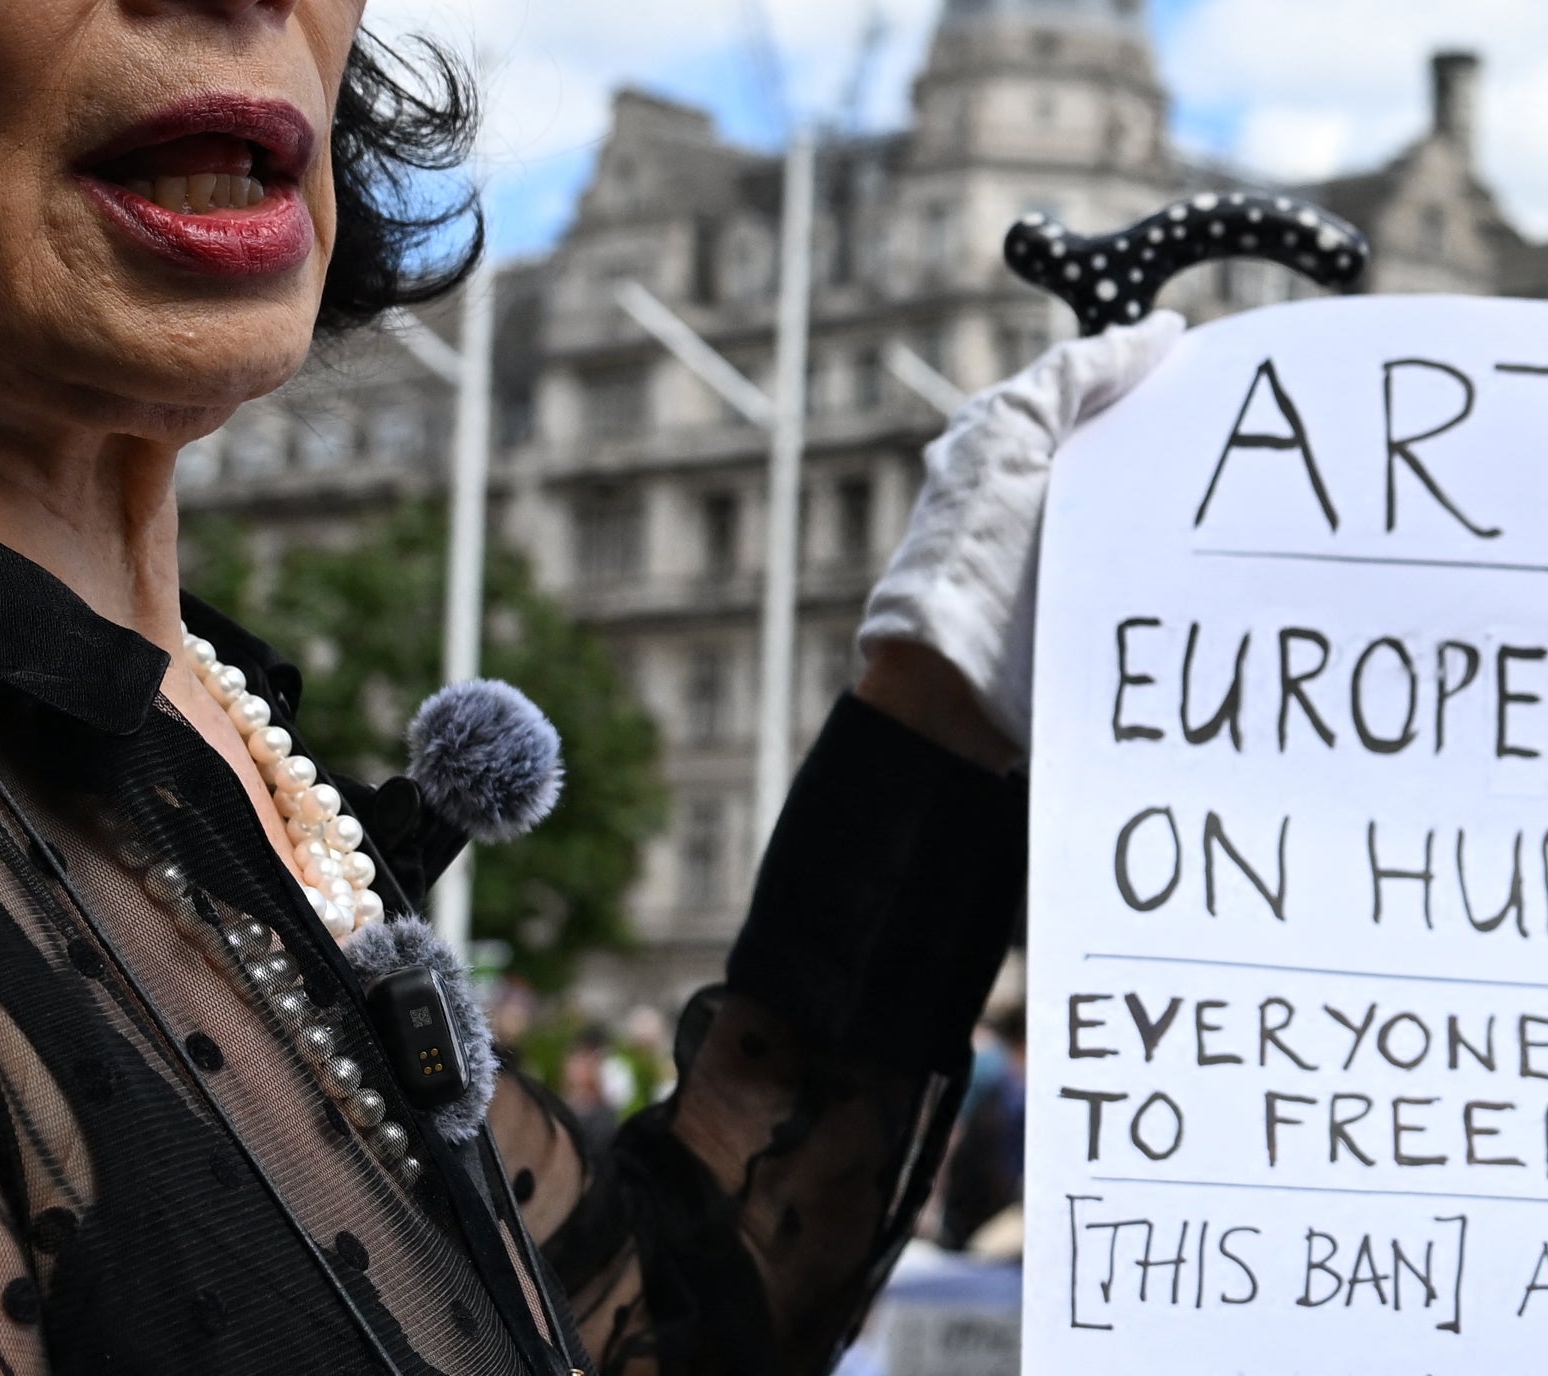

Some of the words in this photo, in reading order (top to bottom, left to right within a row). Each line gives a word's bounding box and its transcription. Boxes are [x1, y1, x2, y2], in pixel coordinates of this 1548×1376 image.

[1114, 806, 1289, 922] ON
[1059, 1087, 1184, 1162] TO
[1066, 1194, 1260, 1331] [THIS
[1295, 1214, 1468, 1335] BAN]
